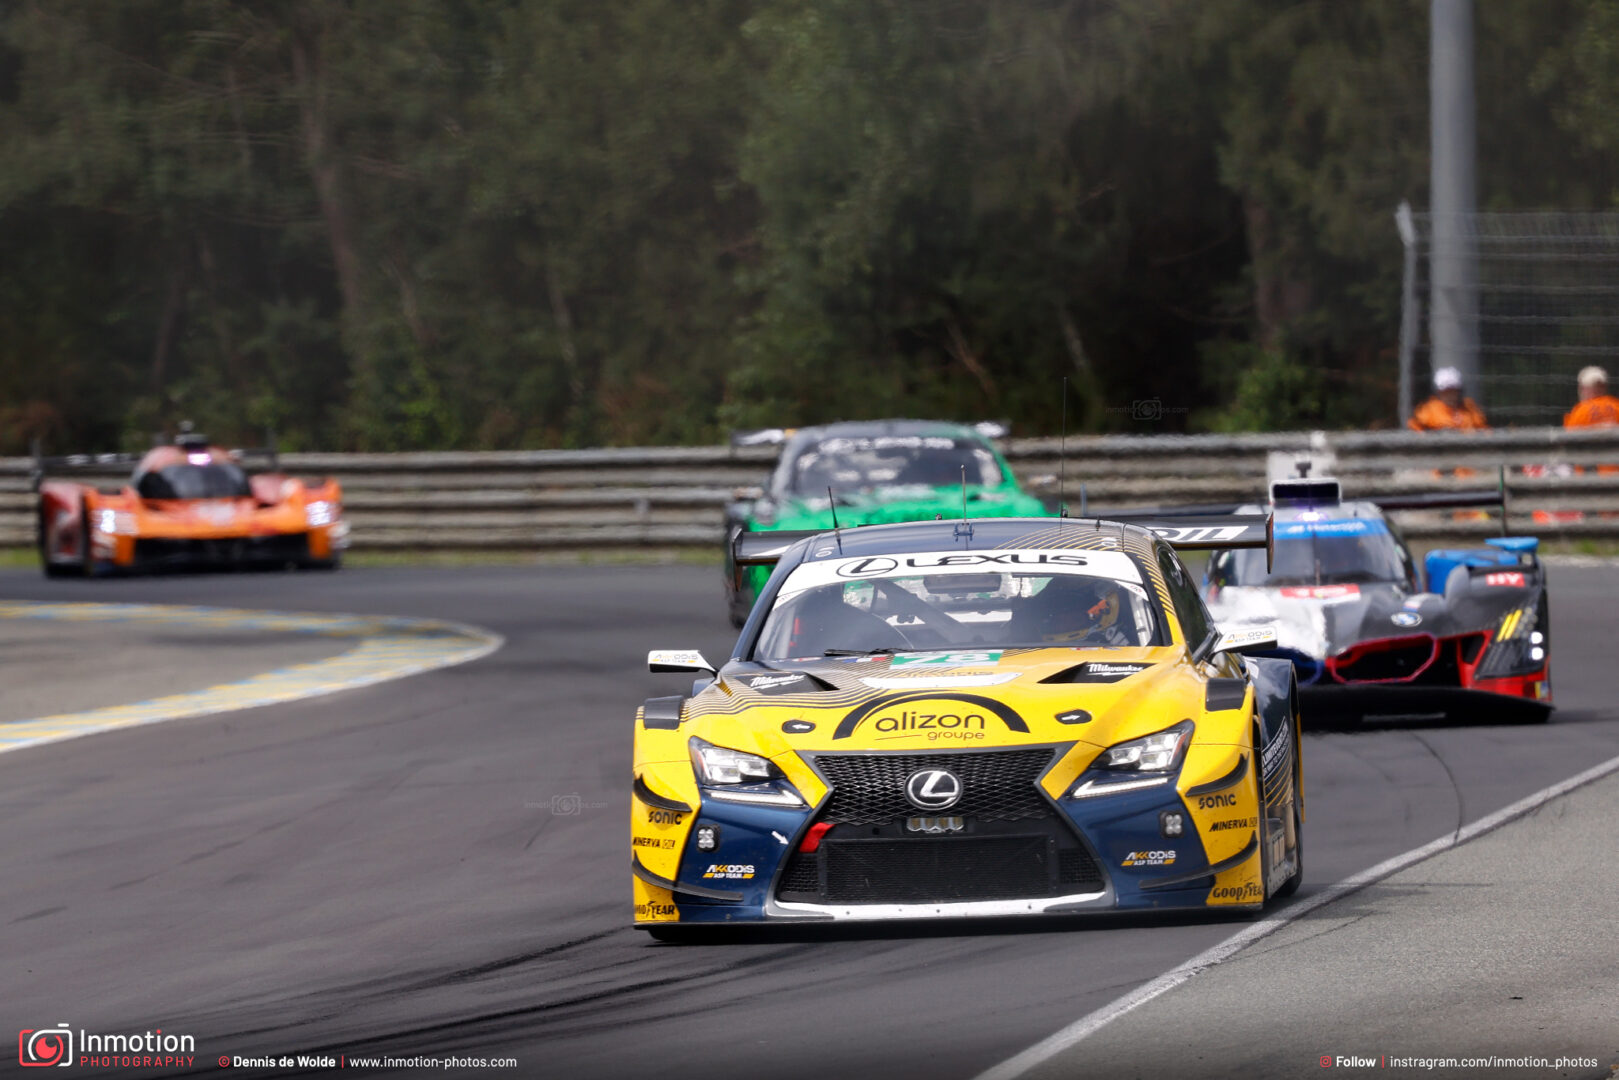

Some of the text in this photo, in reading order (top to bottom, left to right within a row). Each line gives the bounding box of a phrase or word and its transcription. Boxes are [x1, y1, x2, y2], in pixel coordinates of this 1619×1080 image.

[906, 553, 1088, 567] LEXUS
[875, 711, 985, 732] alizon
[927, 731, 985, 741] groupe
[1209, 819, 1248, 832] MINERVA
[1126, 850, 1176, 860] AKKODIS
[706, 864, 755, 873] AKKODIS
